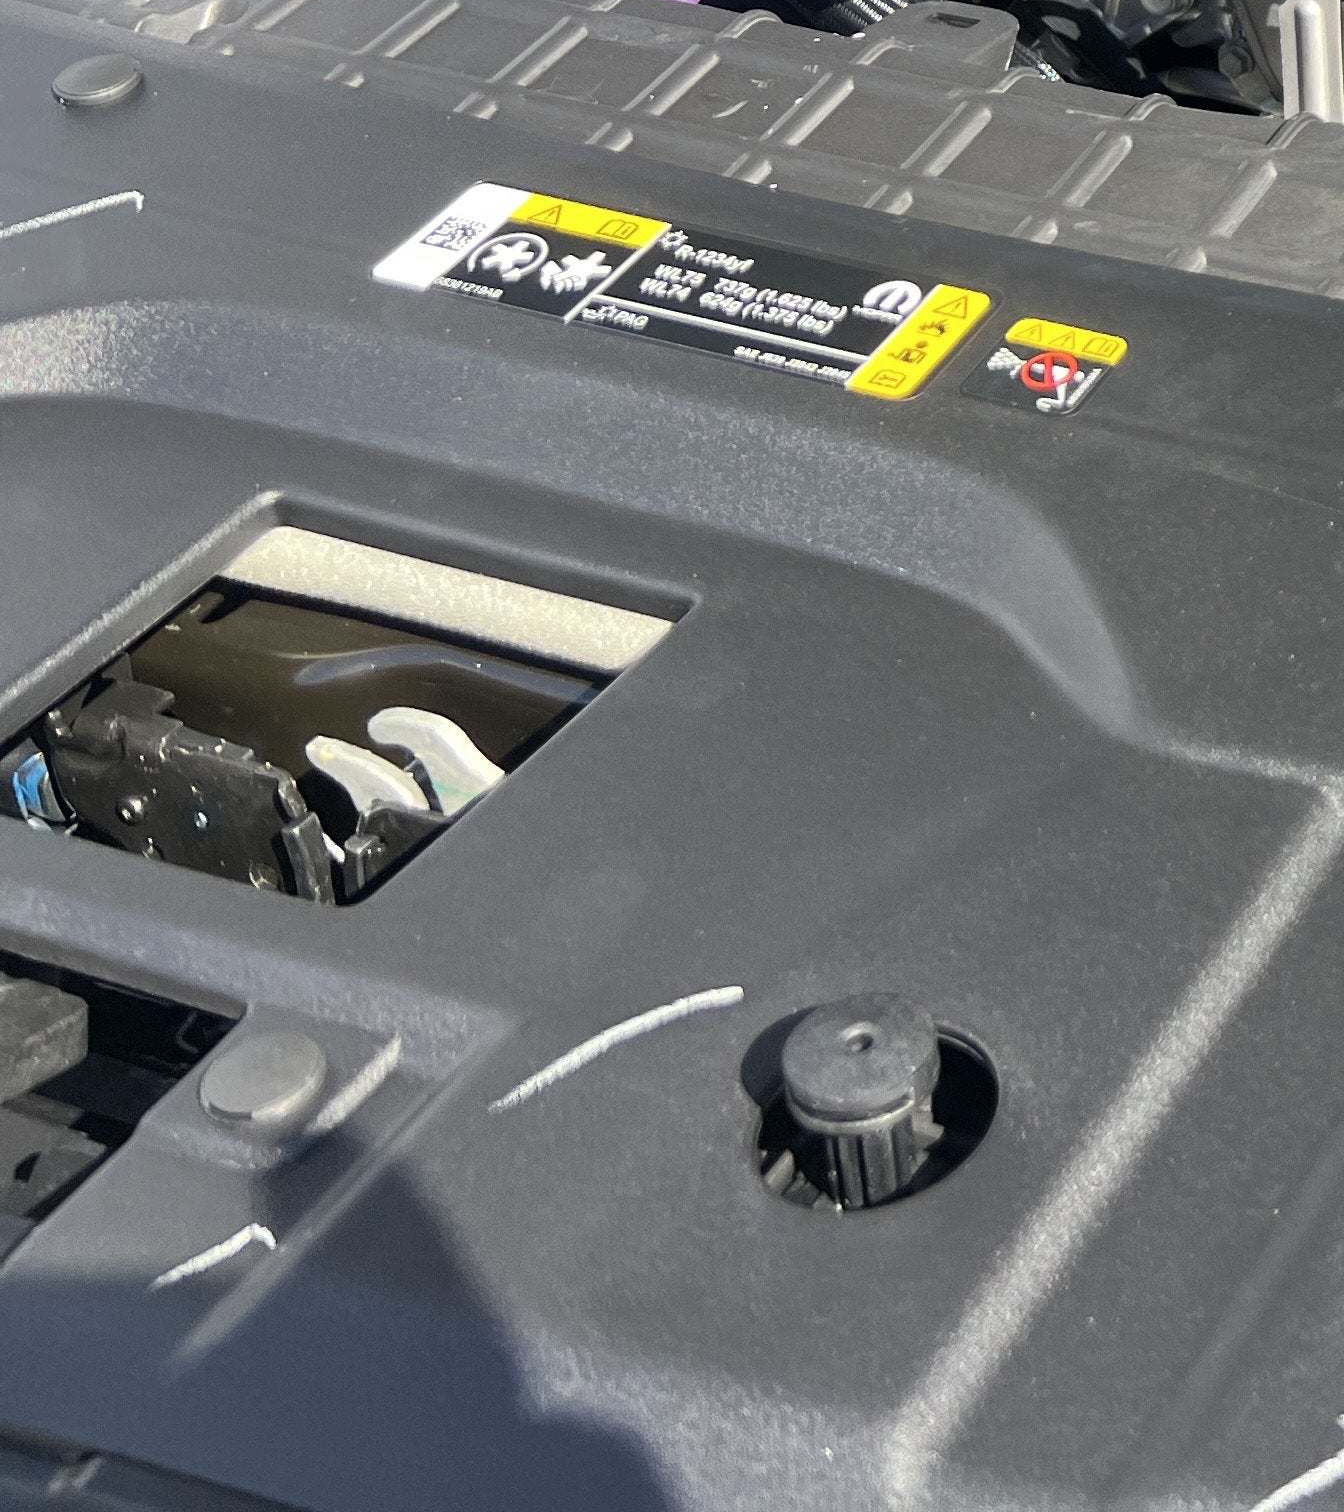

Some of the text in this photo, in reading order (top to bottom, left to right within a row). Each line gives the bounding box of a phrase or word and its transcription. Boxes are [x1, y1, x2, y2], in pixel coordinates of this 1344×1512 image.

[674, 244, 754, 274] R-1234yf
[654, 264, 707, 287] WL75
[639, 277, 692, 302] WL74
